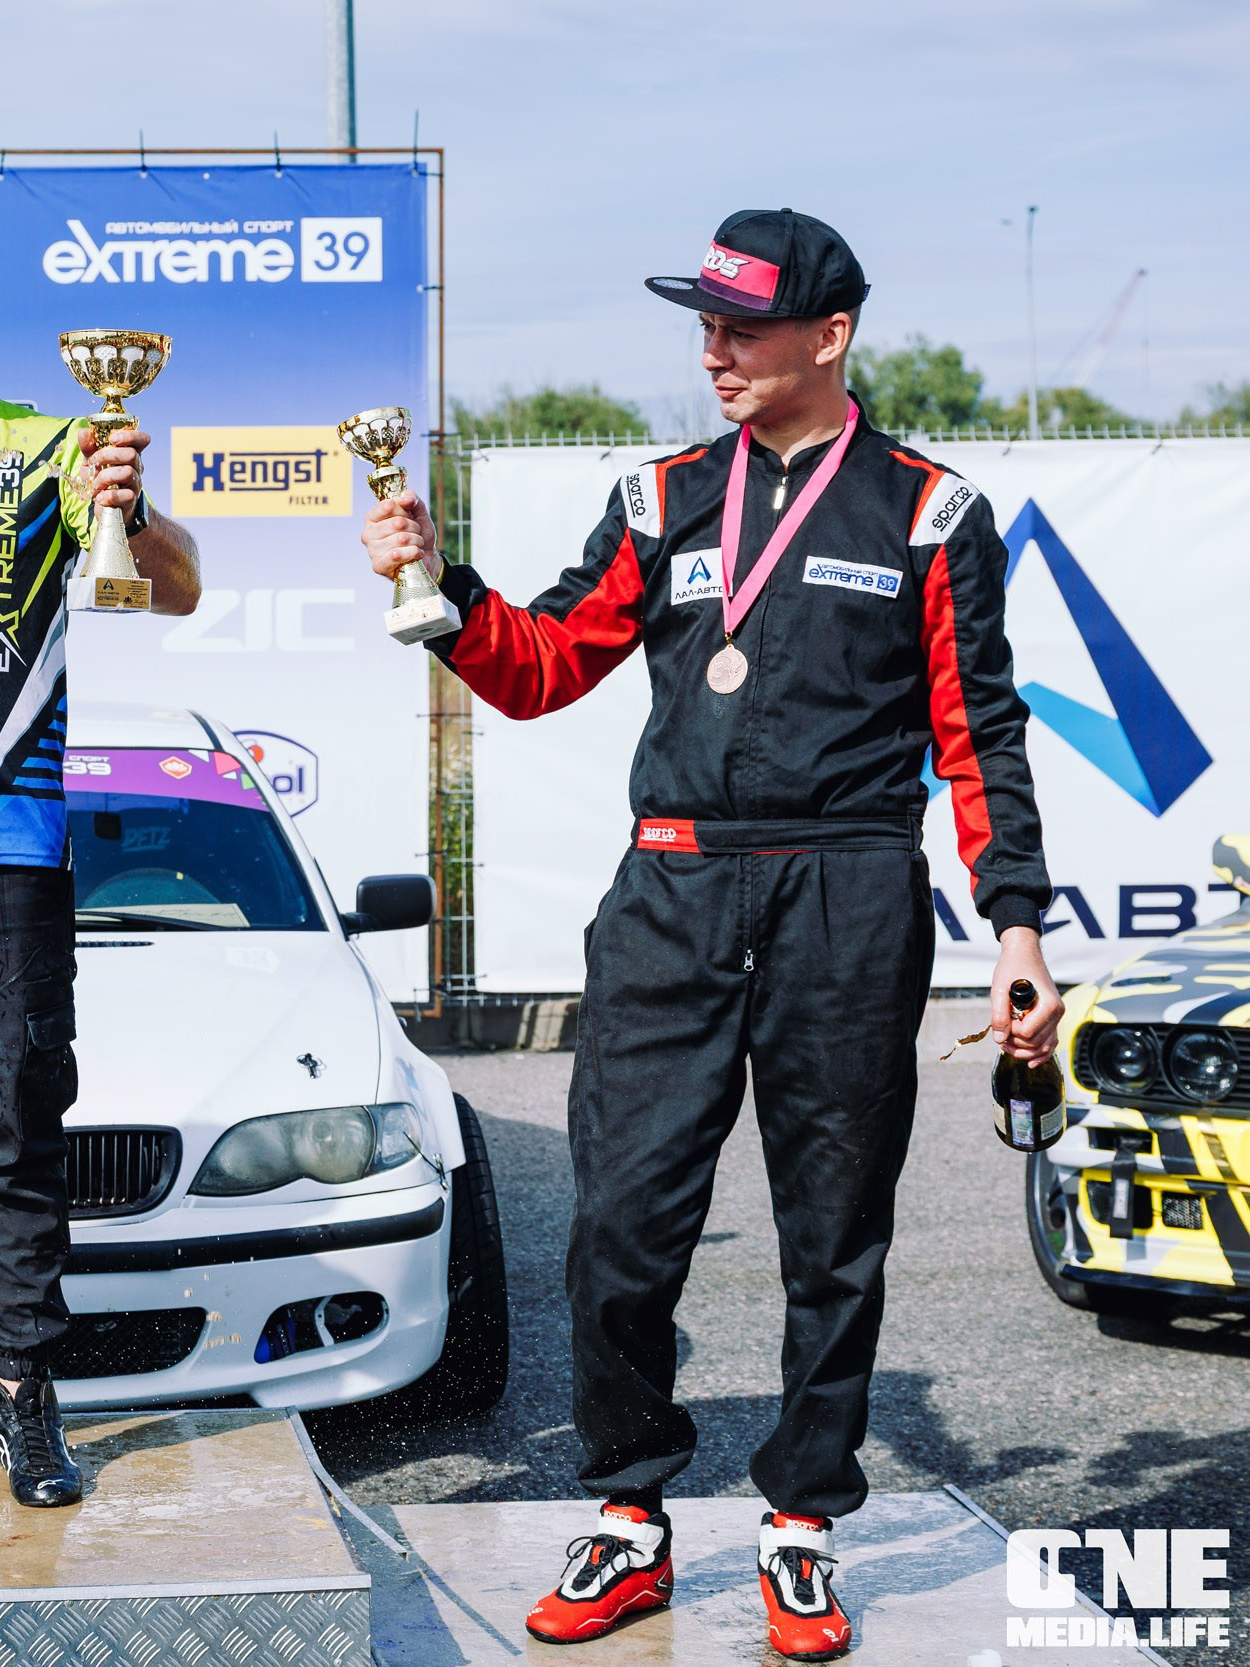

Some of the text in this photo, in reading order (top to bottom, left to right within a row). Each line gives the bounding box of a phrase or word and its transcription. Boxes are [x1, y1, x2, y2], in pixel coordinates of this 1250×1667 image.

[106, 219, 294, 234] АВТОМОБИЛЬНЫЙ СПОРТ
[314, 231, 370, 271] 39
[192, 449, 329, 492] Hengst
[288, 495, 329, 506] FILTER
[626, 473, 647, 518] sparco
[932, 486, 973, 532] sparco
[878, 576, 896, 590] 39
[161, 589, 355, 652] ZIC
[68, 755, 110, 763] СПОРТ
